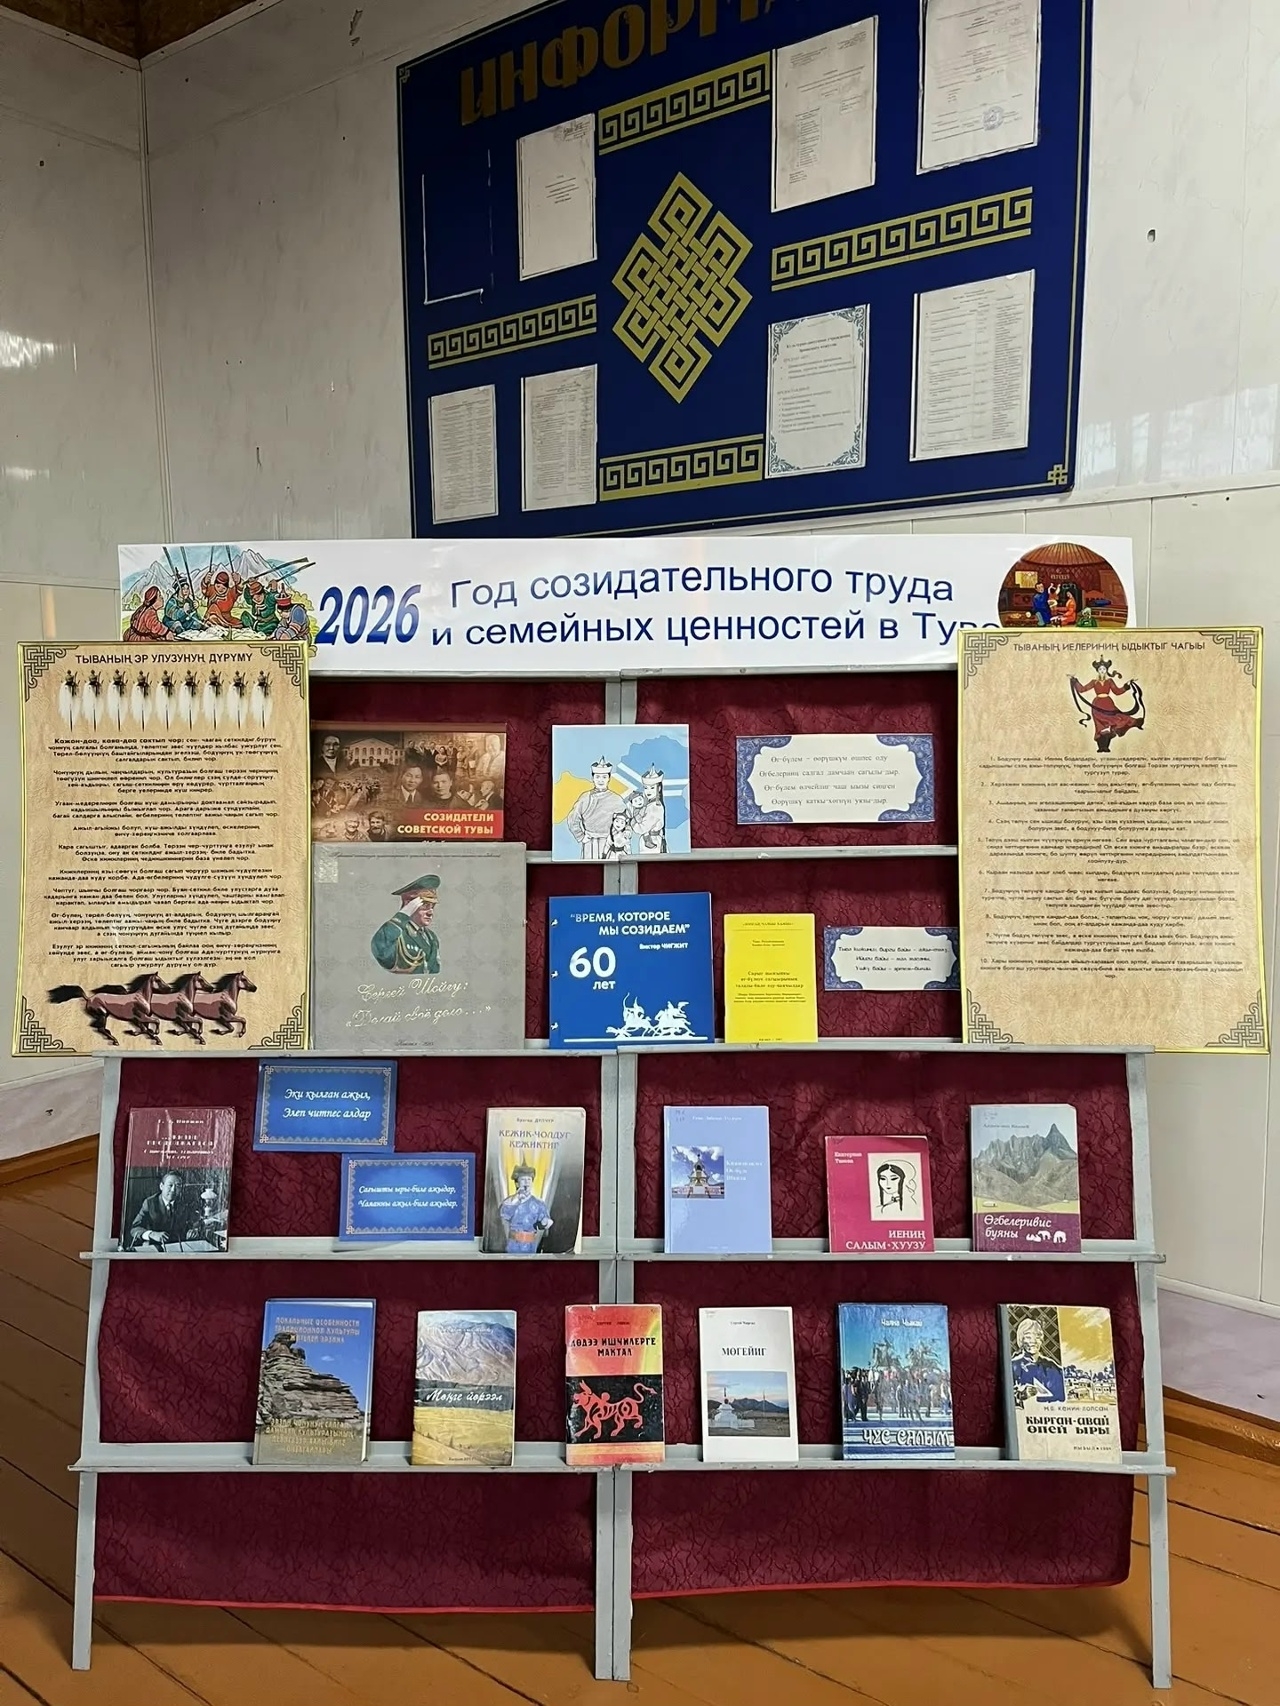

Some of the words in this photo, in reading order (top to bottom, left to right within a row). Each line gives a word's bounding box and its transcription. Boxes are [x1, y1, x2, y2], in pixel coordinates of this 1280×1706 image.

[451, 579, 518, 609] Год
[530, 565, 832, 601] созидательного
[845, 570, 954, 604] труда
[314, 584, 422, 647] 2026
[432, 627, 452, 646] и
[465, 612, 655, 646] семейных
[667, 609, 865, 646] ценностей
[880, 617, 898, 640] в
[75, 654, 133, 664] ТЫВАНЫҢ
[134, 654, 149, 663] ЭР
[151, 653, 206, 663] УЛУЗУНУҢ
[208, 653, 253, 664] ДҮРҮМҮ
[423, 813, 494, 822] СОЗИДАТЕЛИ
[397, 825, 462, 834] СОВЕТСКОЙ
[464, 826, 494, 834] ТУВЫ
[617, 911, 671, 922] КОТОРОЕ
[599, 925, 619, 936] МЫ
[569, 946, 616, 979] 60
[593, 980, 616, 990] лет
[983, 1214, 1052, 1230] Өгбелеривис
[985, 1228, 1019, 1240] буяны
[601, 1337, 656, 1346] ИШЧИЛЕРГЕ
[597, 1348, 632, 1357] МАКТАЛ
